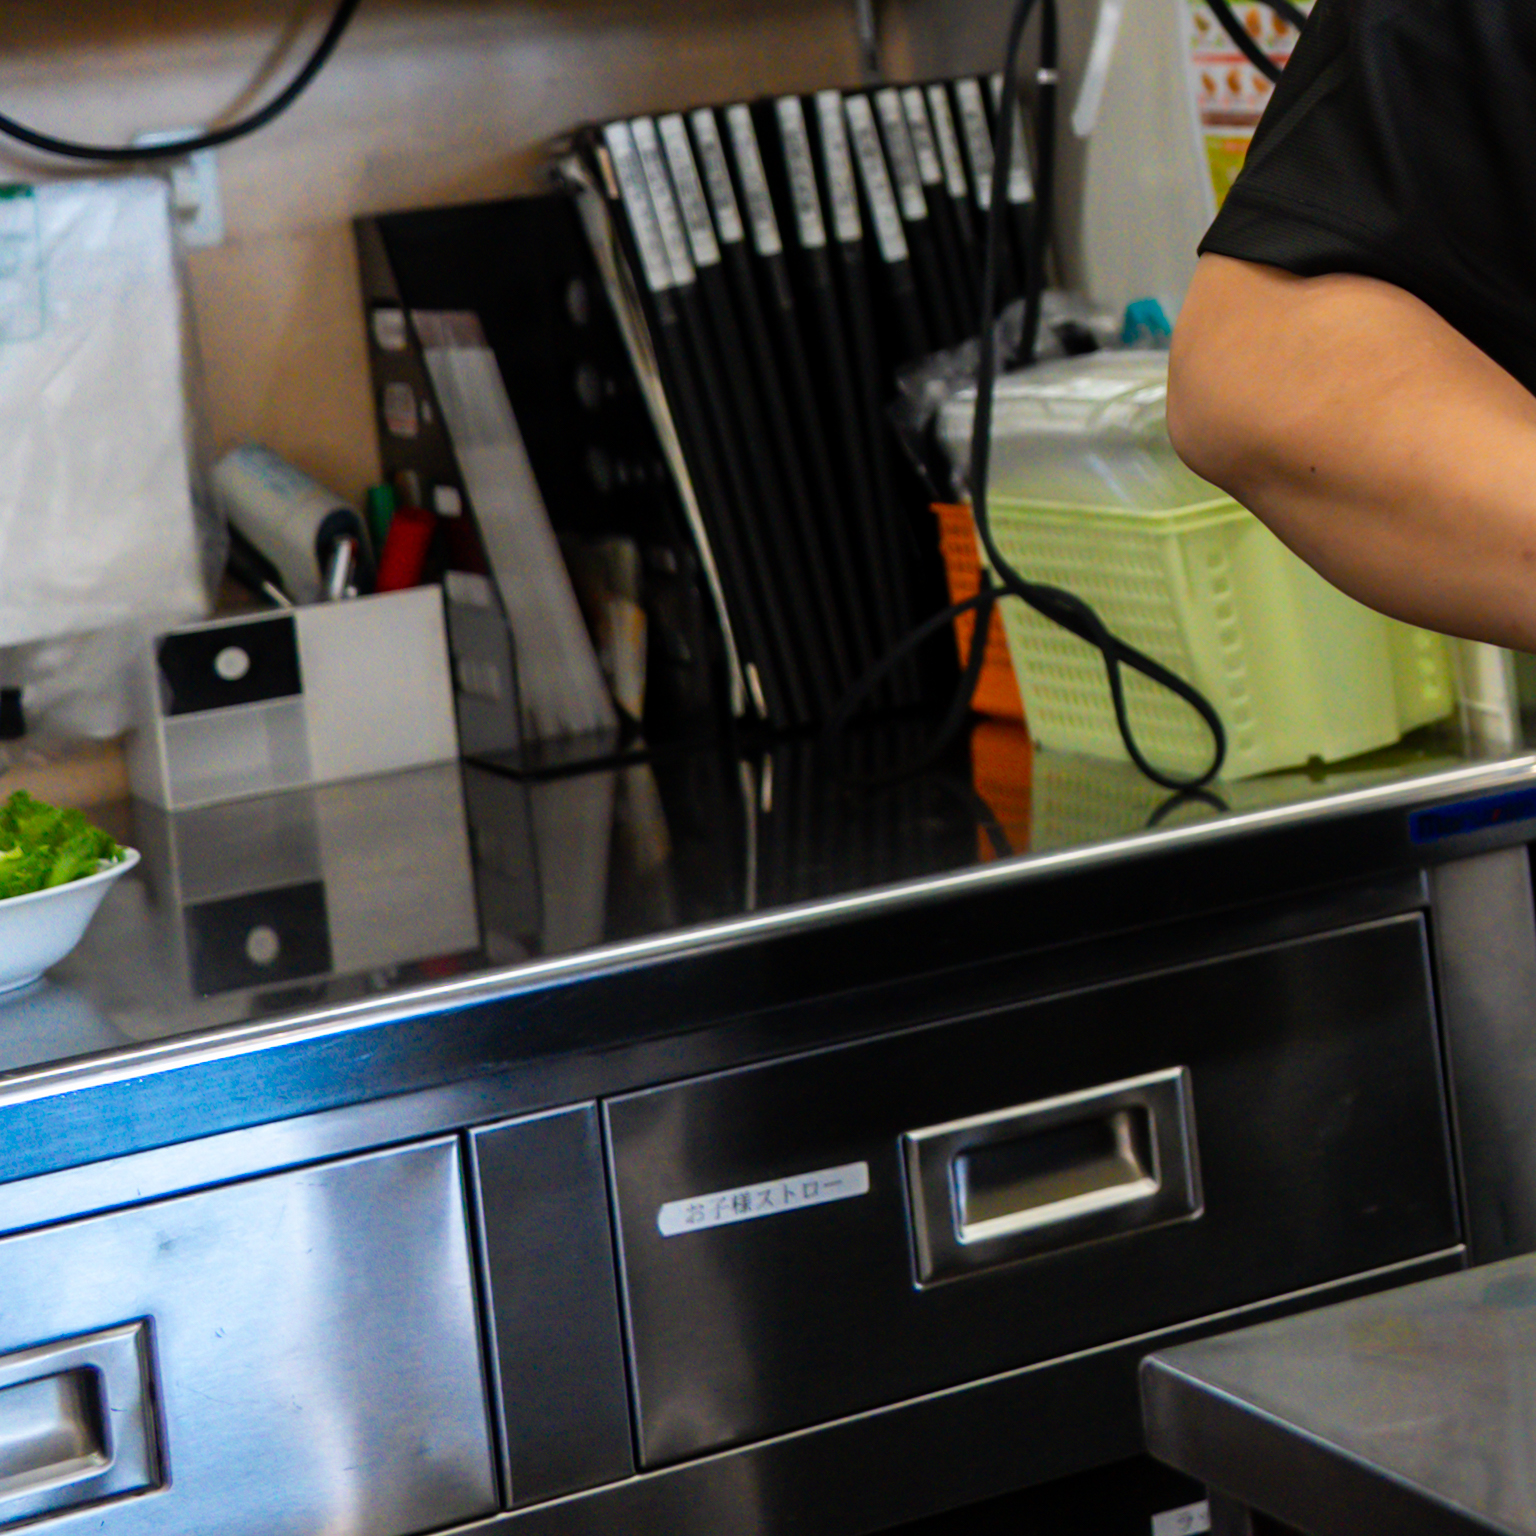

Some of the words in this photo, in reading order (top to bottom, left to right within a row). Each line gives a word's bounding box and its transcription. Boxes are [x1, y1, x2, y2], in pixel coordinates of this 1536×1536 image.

[686, 1179, 843, 1224] お子様ストロー
